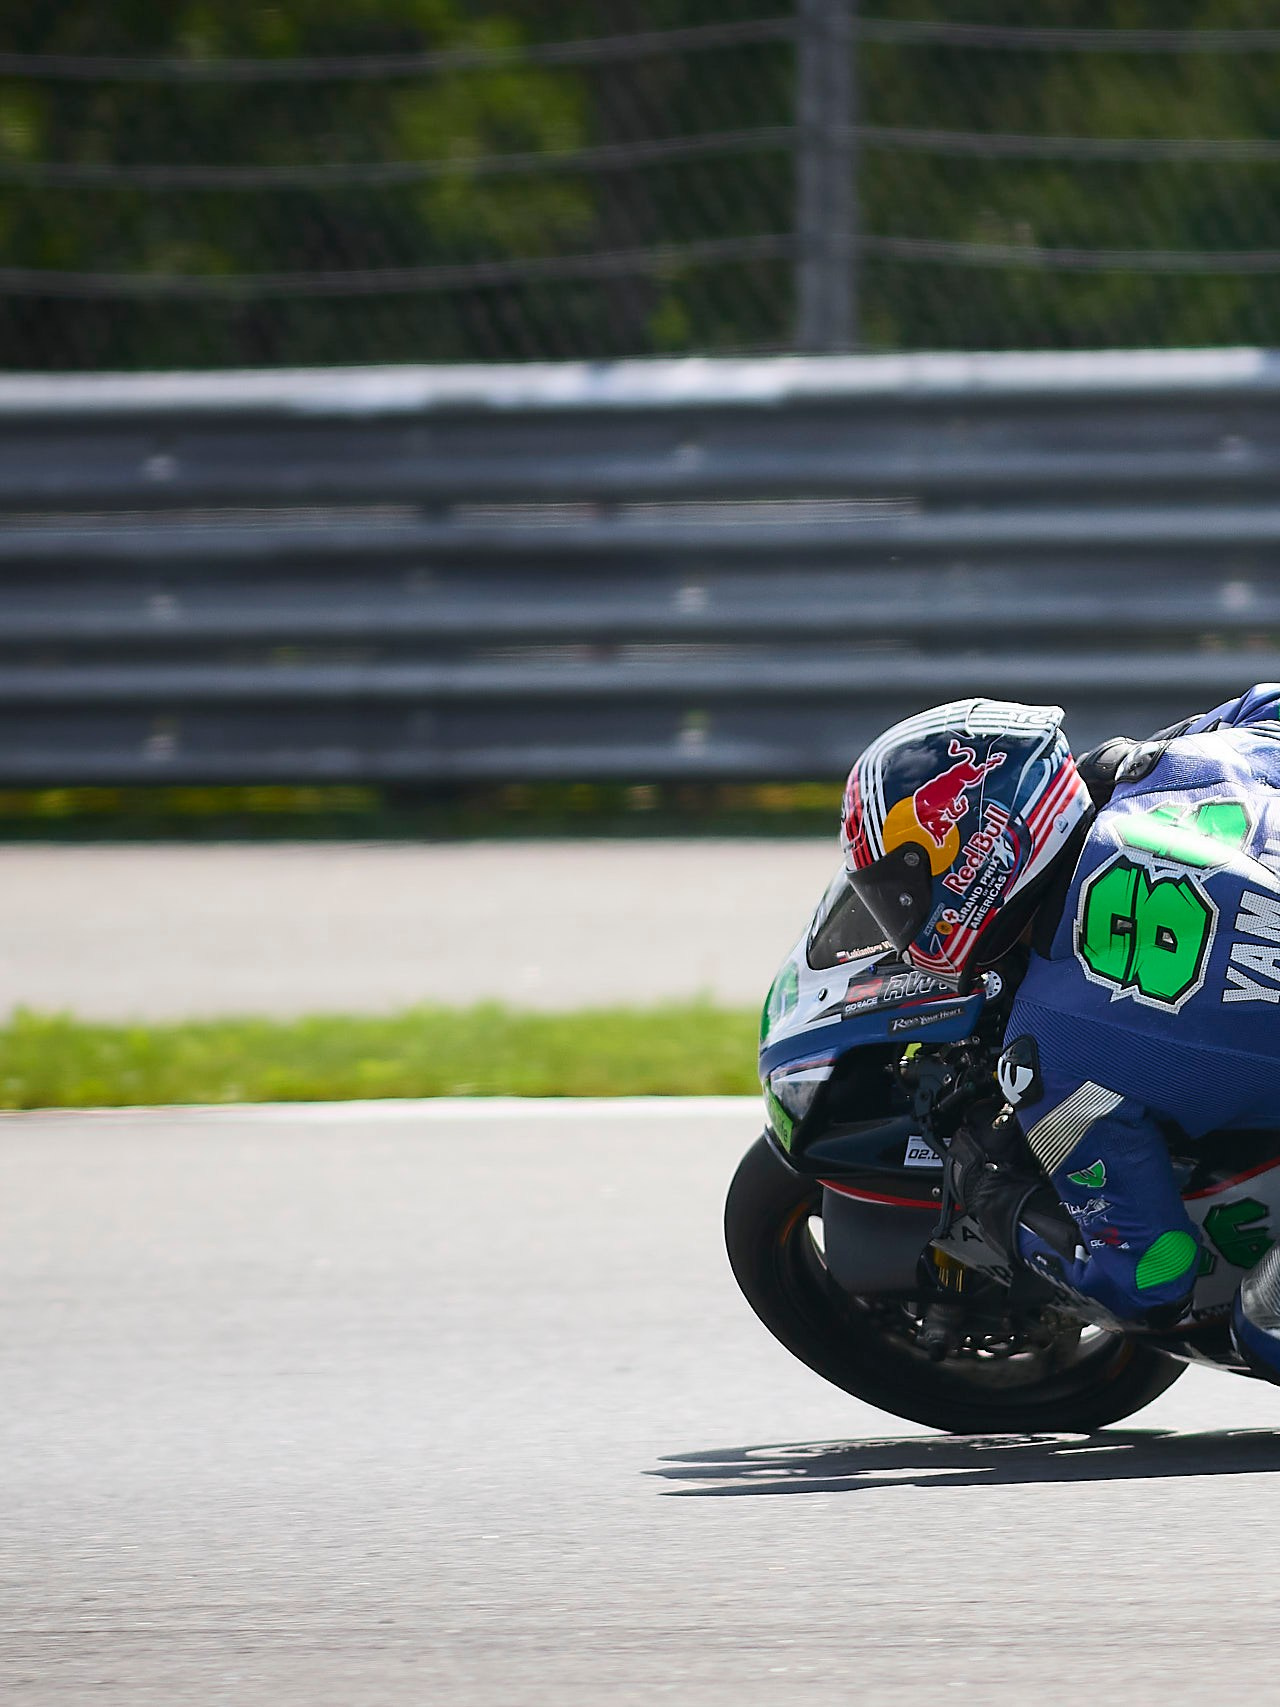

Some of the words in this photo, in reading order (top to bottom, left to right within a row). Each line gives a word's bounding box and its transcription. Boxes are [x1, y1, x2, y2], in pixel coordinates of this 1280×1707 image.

[957, 886, 983, 922] GRAND
[980, 857, 1000, 887] PRIX
[970, 875, 1007, 929] AMERICAS
